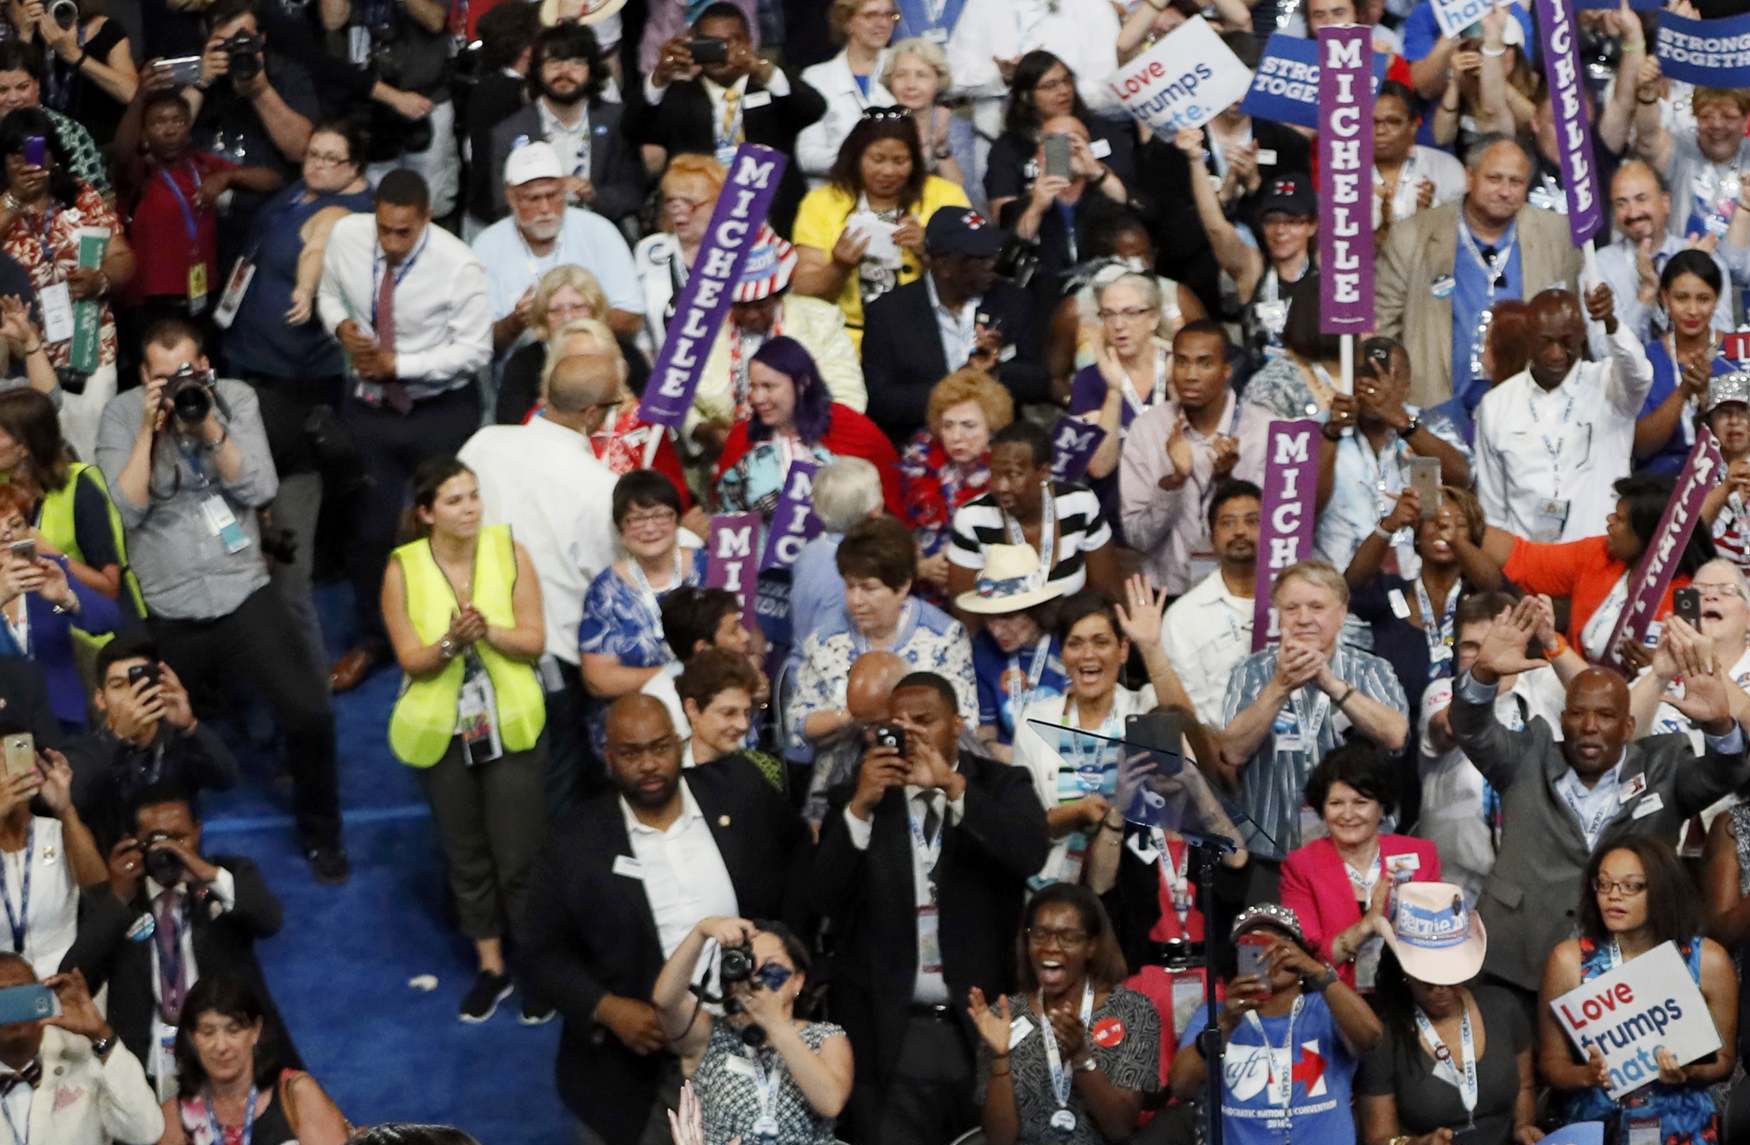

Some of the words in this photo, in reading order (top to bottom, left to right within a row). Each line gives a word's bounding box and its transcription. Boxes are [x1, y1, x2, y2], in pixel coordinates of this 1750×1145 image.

[1109, 61, 1166, 101] Love
[1131, 62, 1213, 121] trumps
[1326, 38, 1363, 303] MICHELLE
[659, 156, 775, 398] MICHELLE
[1560, 982, 1634, 1030] Love
[1581, 998, 1682, 1055] trumps
